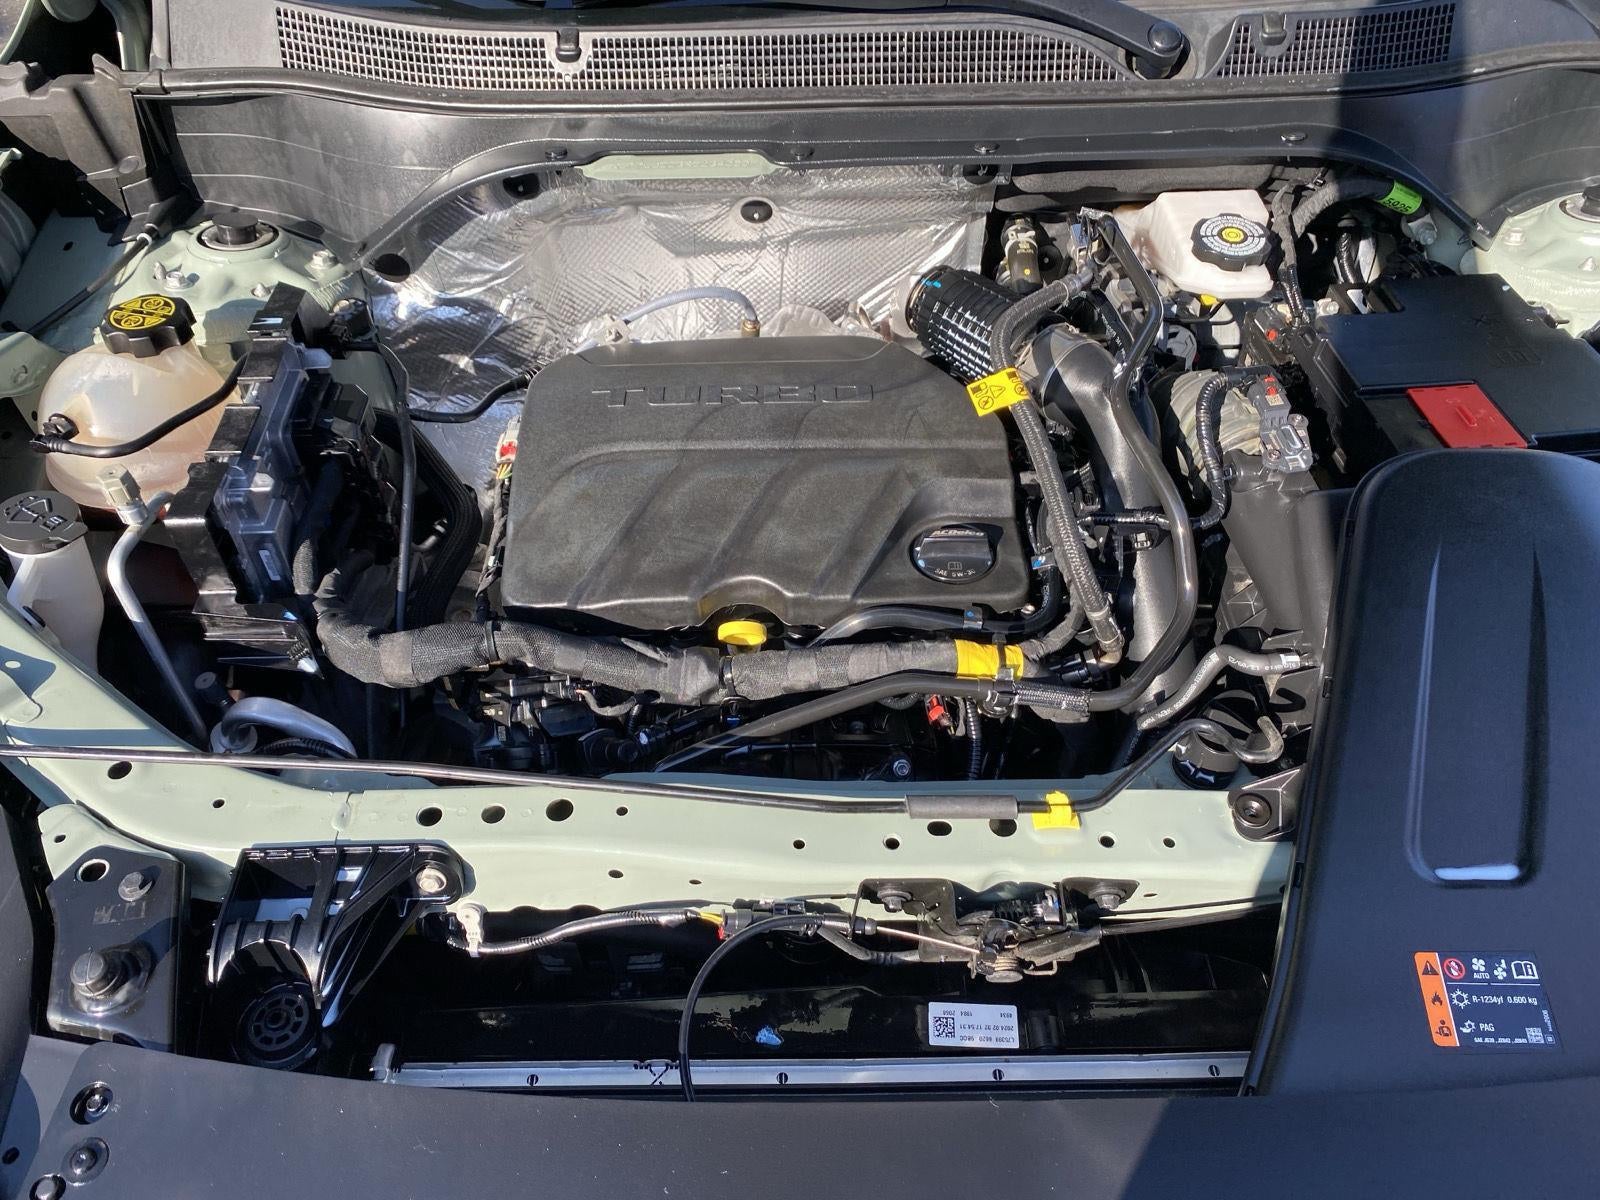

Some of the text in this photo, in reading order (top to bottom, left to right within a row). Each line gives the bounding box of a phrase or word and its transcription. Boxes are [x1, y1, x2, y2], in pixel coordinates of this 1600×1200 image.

[592, 384, 874, 407] TURBO
[930, 529, 985, 537] ACDelco
[1472, 996, 1538, 1005] R-1234yf 0.600 kg
[1479, 1023, 1495, 1032] PAG
